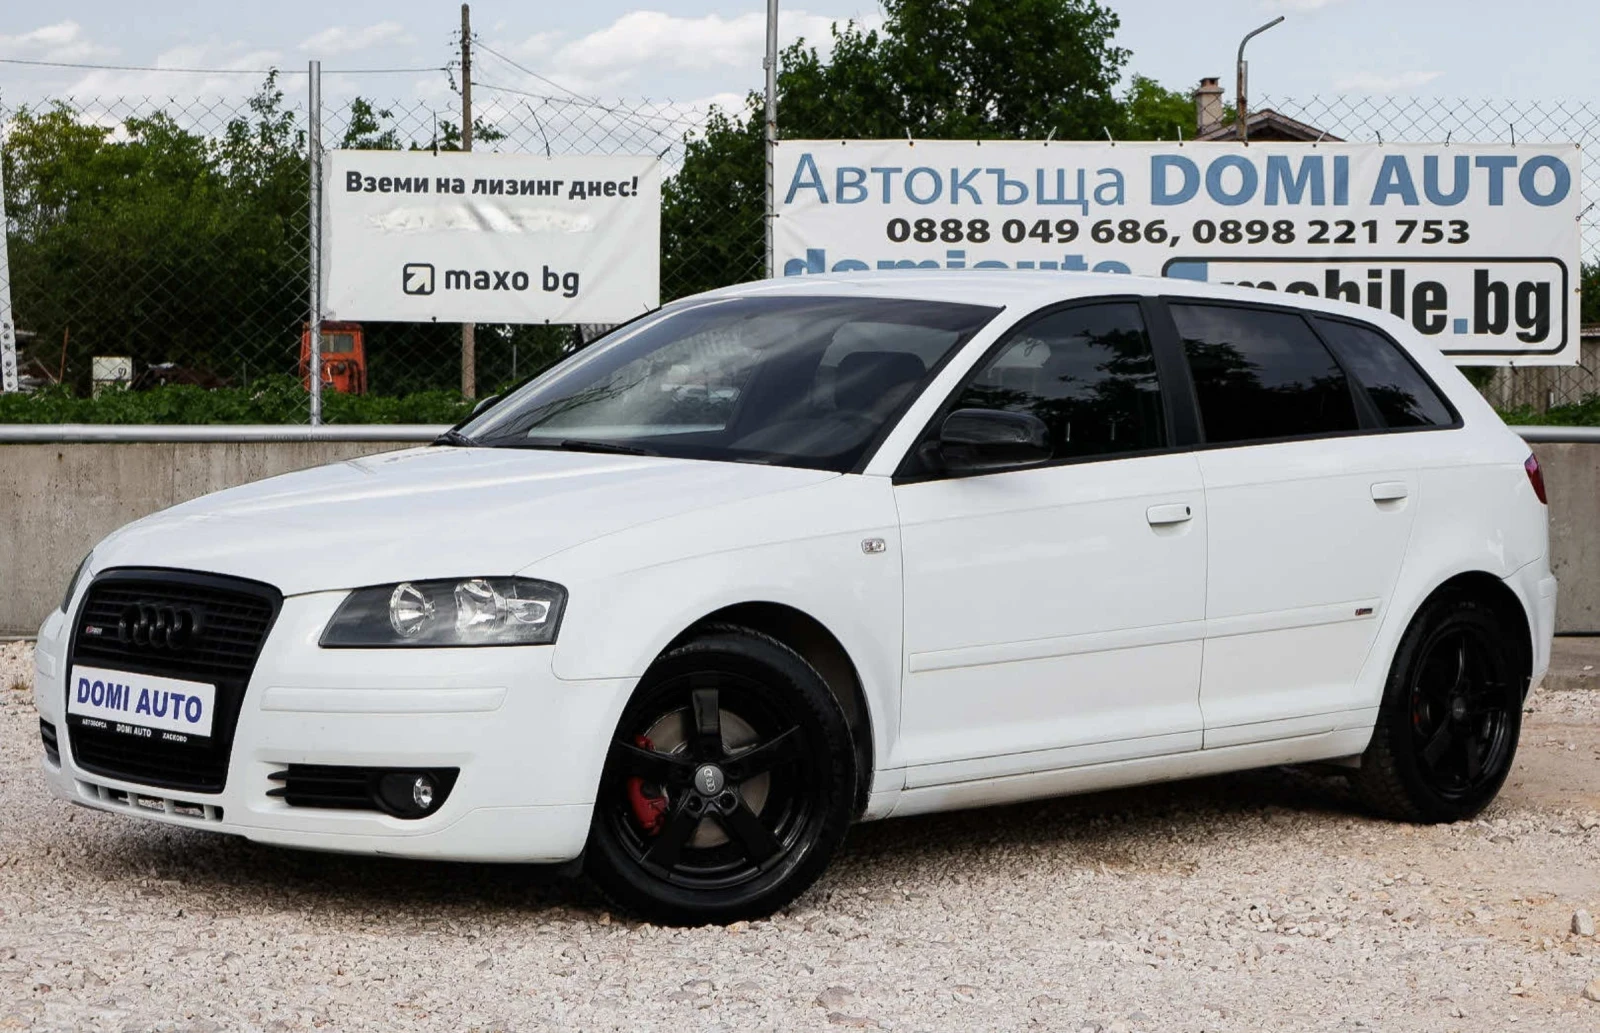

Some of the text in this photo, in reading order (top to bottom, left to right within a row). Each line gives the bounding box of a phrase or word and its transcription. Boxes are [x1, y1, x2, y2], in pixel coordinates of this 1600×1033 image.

[346, 170, 639, 201] Вземи на лизинг днес!
[784, 153, 1572, 217] Автокъща DOMI AUTO
[886, 217, 1471, 248] 0888 049 686, 0898 221 753
[444, 264, 580, 299] maxo bg
[1220, 268, 1551, 344] ile.bg
[77, 677, 203, 724] DOMI AUTO
[116, 723, 133, 735] DOMI
[133, 727, 152, 738] AUTO
